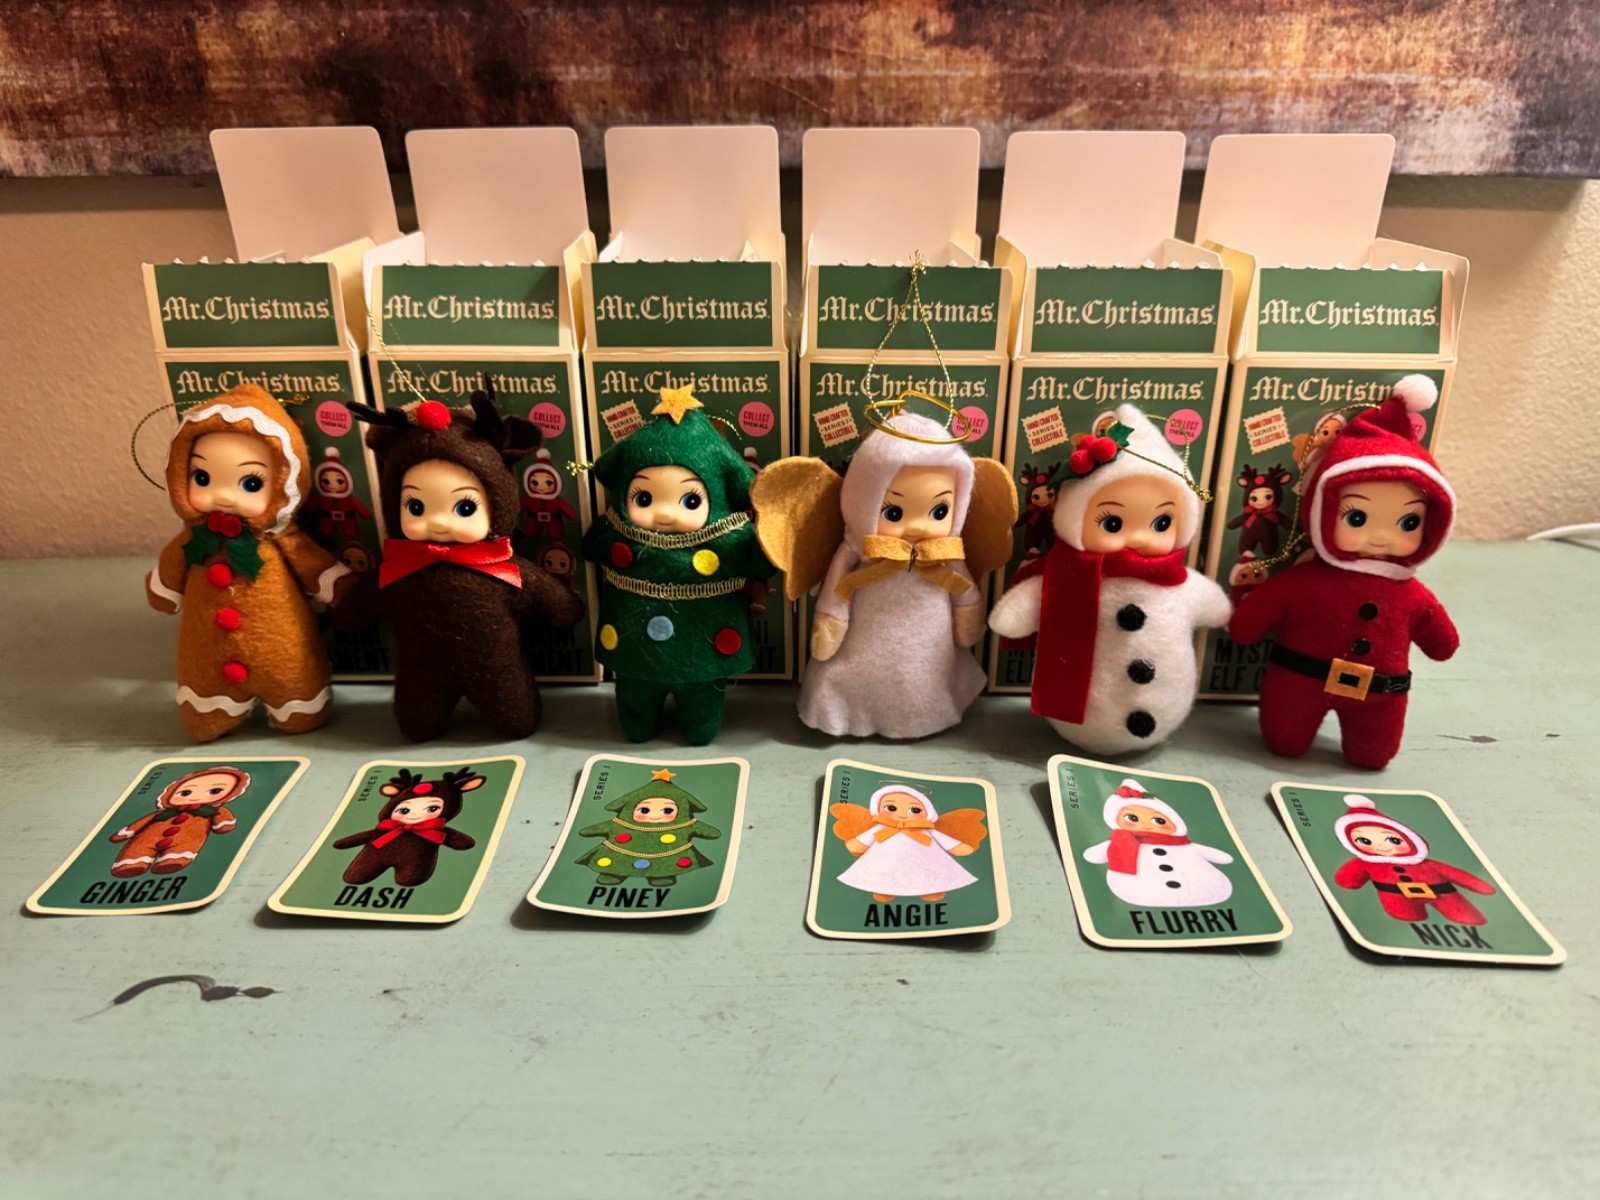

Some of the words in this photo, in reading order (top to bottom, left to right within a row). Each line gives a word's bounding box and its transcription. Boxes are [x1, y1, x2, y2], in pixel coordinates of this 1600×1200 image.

[320, 410, 347, 422] COLLECT
[533, 411, 562, 425] COLLECT
[743, 410, 770, 423] COLLECT
[957, 415, 985, 428] CLECT
[1210, 666, 1247, 691] ELF
[137, 771, 163, 796] SERIES
[358, 775, 378, 802] SERIES
[593, 771, 609, 801] SERIES
[840, 776, 850, 805] SERIES
[1067, 775, 1080, 809] SERIES
[1291, 797, 1312, 827] SERIES
[80, 876, 187, 904] GINGER
[334, 885, 415, 909] DASH
[587, 885, 672, 909] PINEY
[864, 903, 949, 928] ANGIE
[1129, 908, 1239, 936] FLURRY
[1410, 923, 1494, 949] NICK
